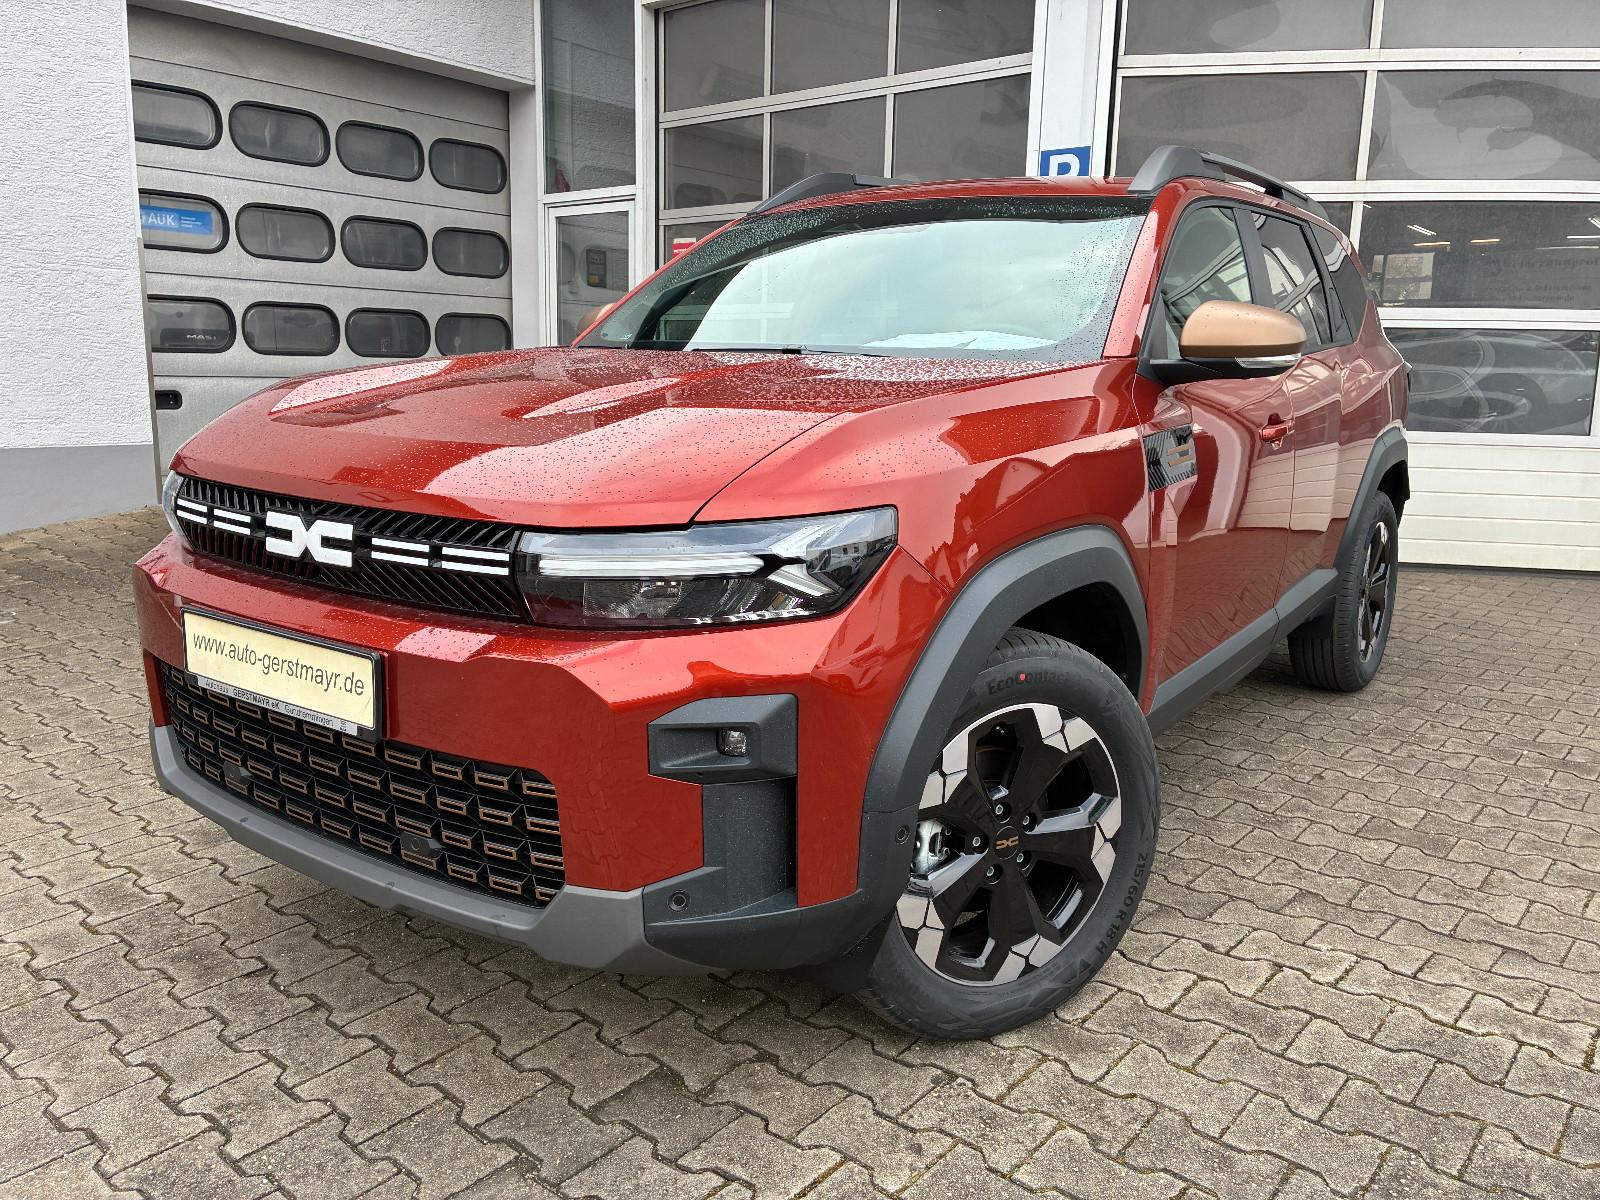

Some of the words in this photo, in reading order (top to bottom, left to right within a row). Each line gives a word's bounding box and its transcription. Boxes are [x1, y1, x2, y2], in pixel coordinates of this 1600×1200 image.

[1049, 153, 1080, 176] P
[193, 632, 365, 696] www.auto-gerstmayr.de
[233, 688, 270, 707] GERSTMAYR
